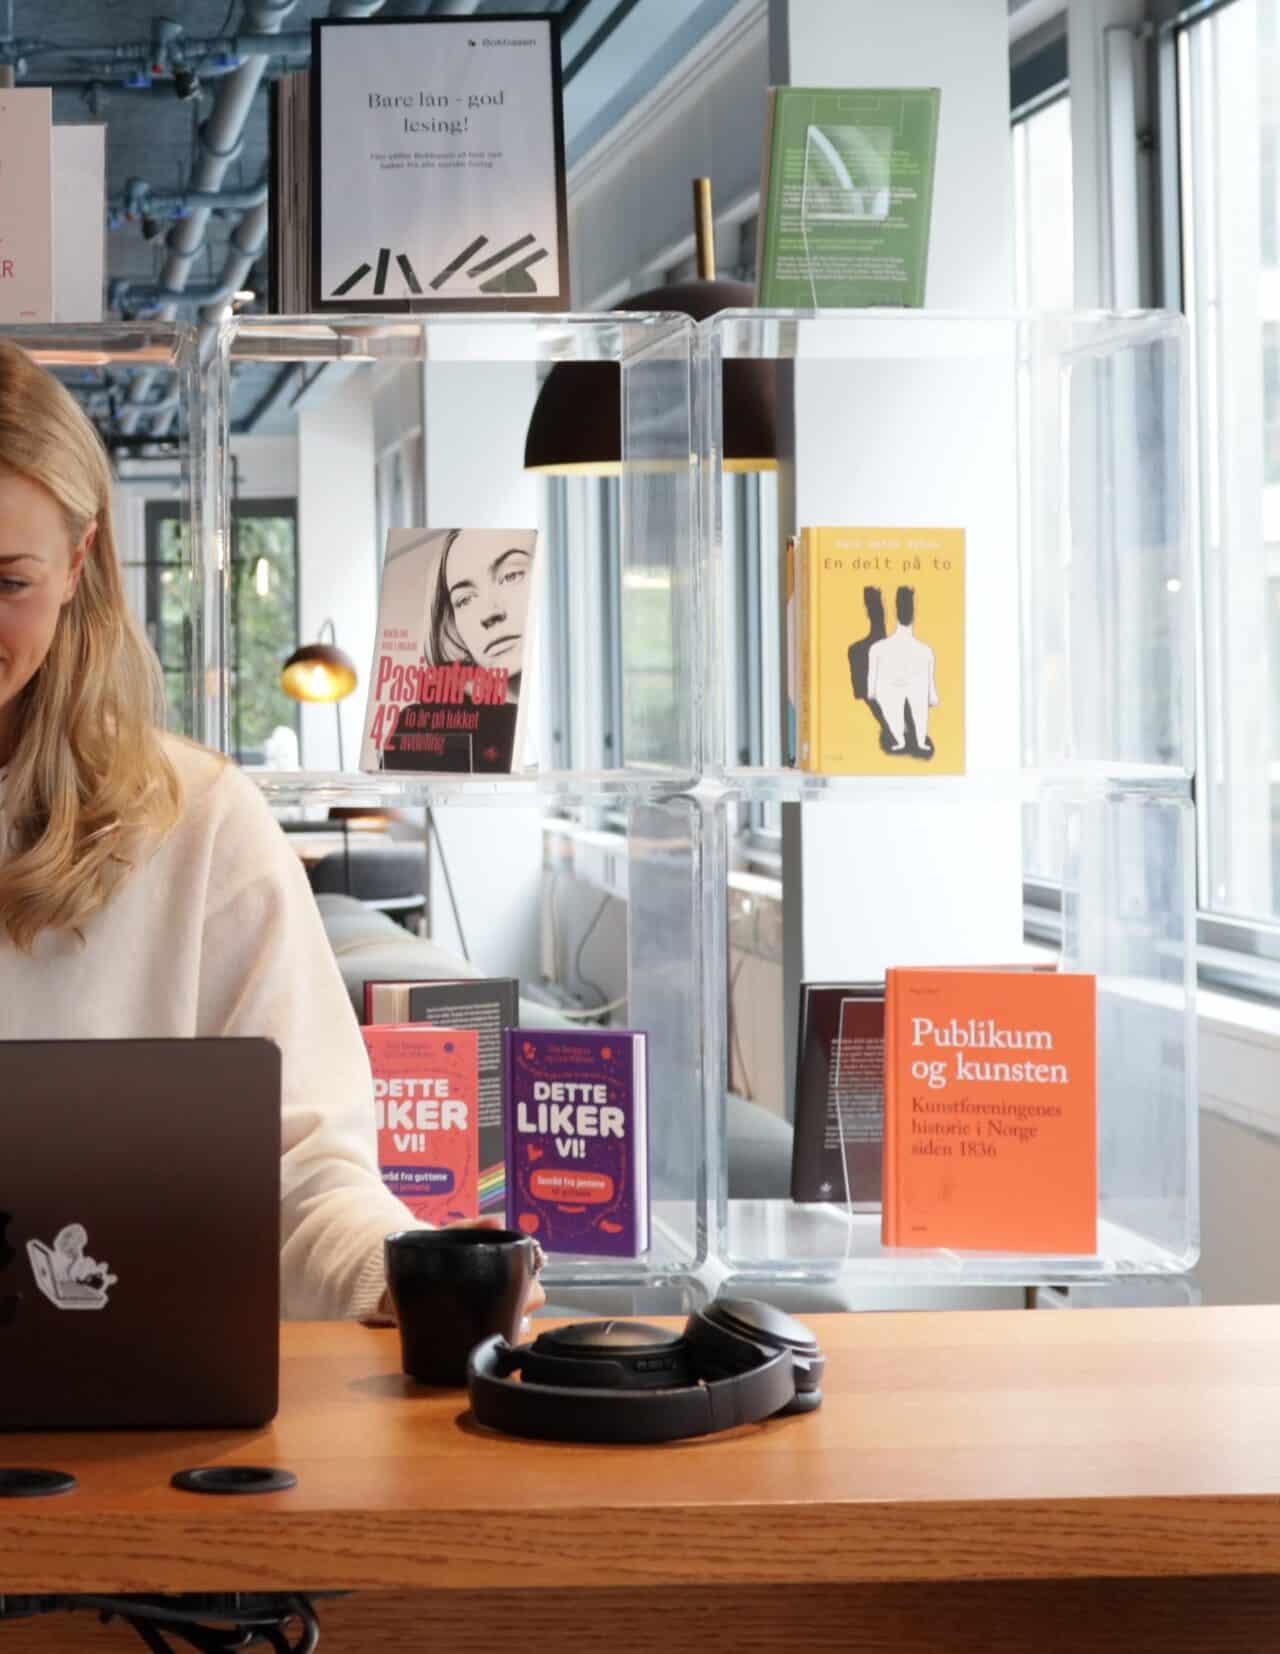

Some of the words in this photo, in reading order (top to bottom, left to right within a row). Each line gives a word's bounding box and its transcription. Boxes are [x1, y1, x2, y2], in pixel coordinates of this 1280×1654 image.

[367, 92, 415, 109] Bare
[467, 90, 505, 109] god
[404, 117, 469, 135] lesing!
[824, 558, 843, 569] En
[933, 558, 952, 570] to
[370, 704, 401, 752] 42
[911, 1016, 1054, 1050] Publikum
[910, 1058, 948, 1089] og
[955, 1052, 1069, 1085] kunsten
[374, 1078, 450, 1098] DETTE
[533, 1081, 608, 1104] DETTE
[375, 1098, 469, 1131] IKER
[517, 1101, 626, 1138] LIKER
[911, 1097, 1063, 1120] Kunstforeningenes
[911, 1118, 971, 1137] historie
[986, 1119, 1039, 1141] Norge
[392, 1133, 426, 1153] VI!
[554, 1136, 587, 1159] VI!
[911, 1139, 953, 1157] siden
